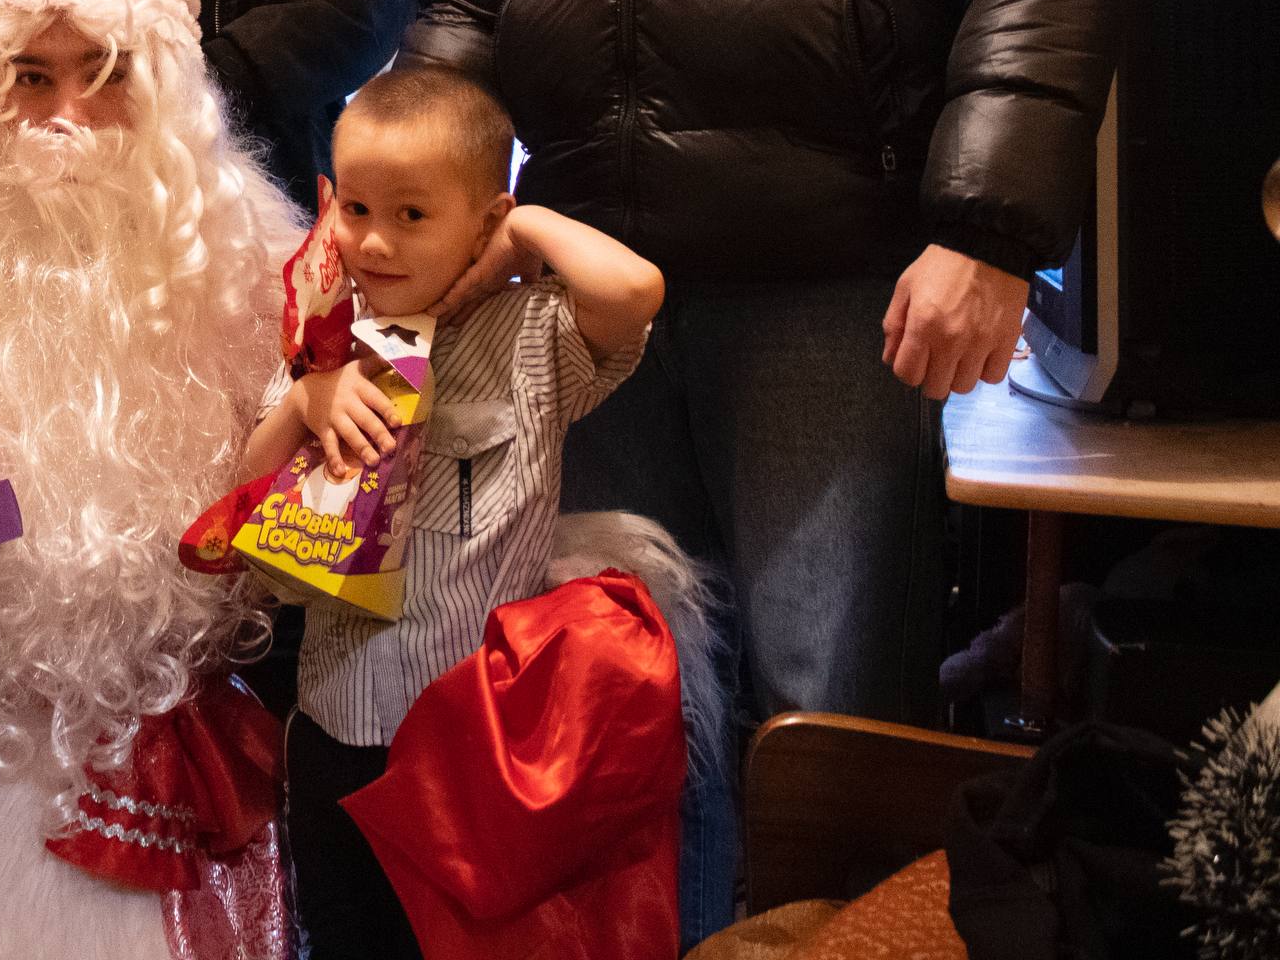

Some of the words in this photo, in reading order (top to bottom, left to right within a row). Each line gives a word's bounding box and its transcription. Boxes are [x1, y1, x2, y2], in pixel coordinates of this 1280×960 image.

[260, 492, 287, 519] С
[280, 502, 355, 541] НОВЫМ
[258, 520, 339, 563] ГОДОМ!
